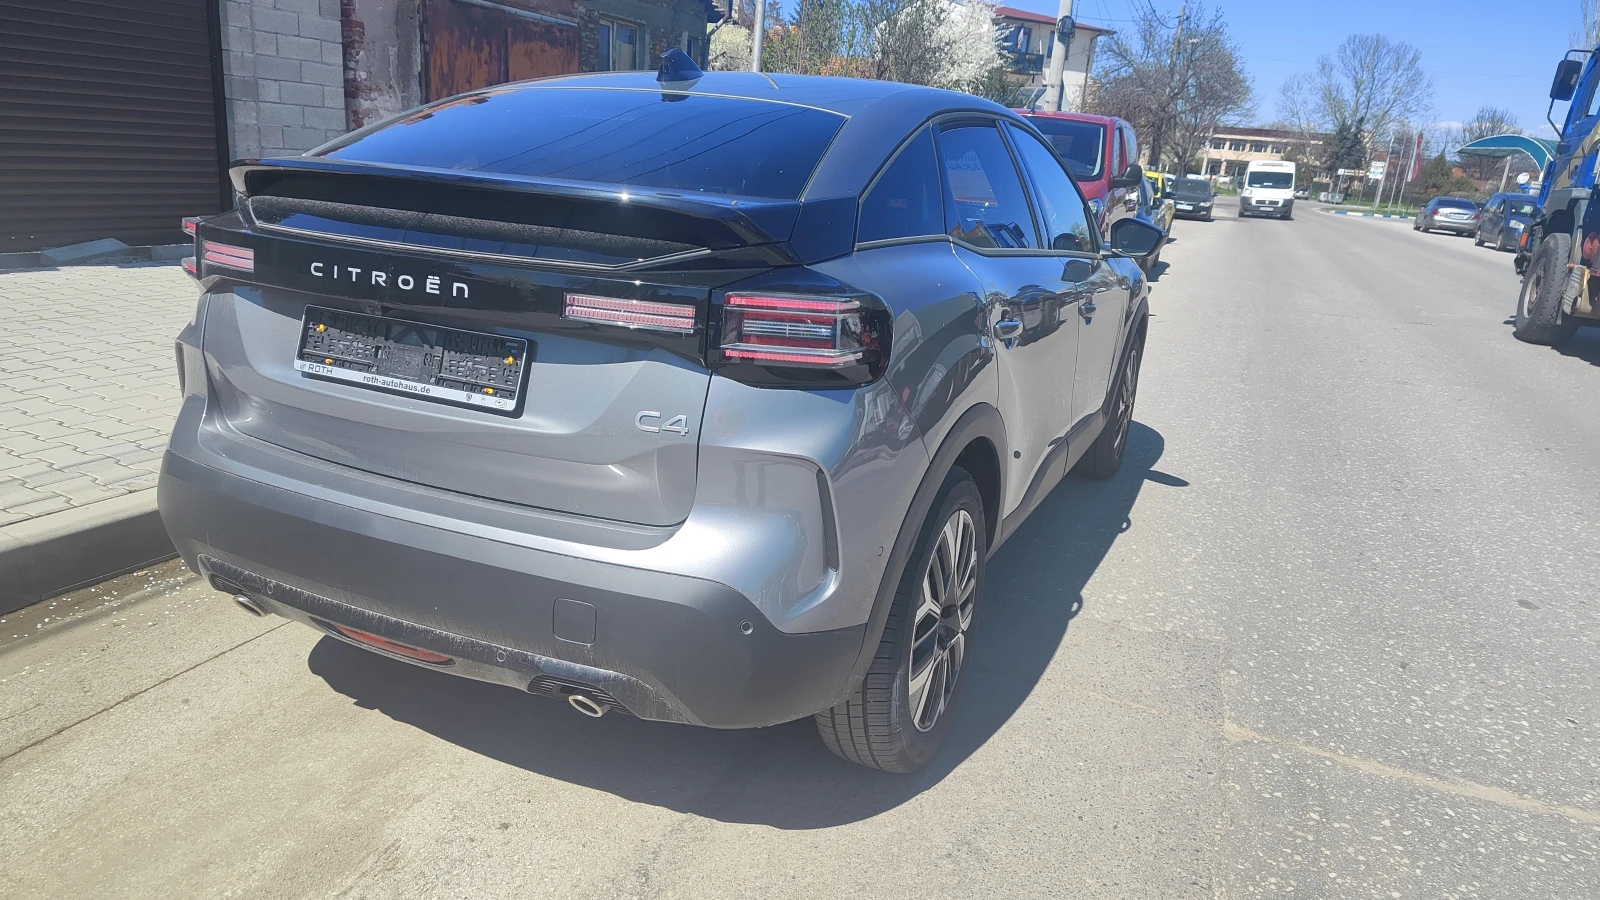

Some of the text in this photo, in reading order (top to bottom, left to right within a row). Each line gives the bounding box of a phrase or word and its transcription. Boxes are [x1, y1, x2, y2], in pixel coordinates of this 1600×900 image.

[308, 363, 334, 376] ROTH
[362, 374, 431, 395] roth-autohaus.de
[635, 410, 689, 436] C4
